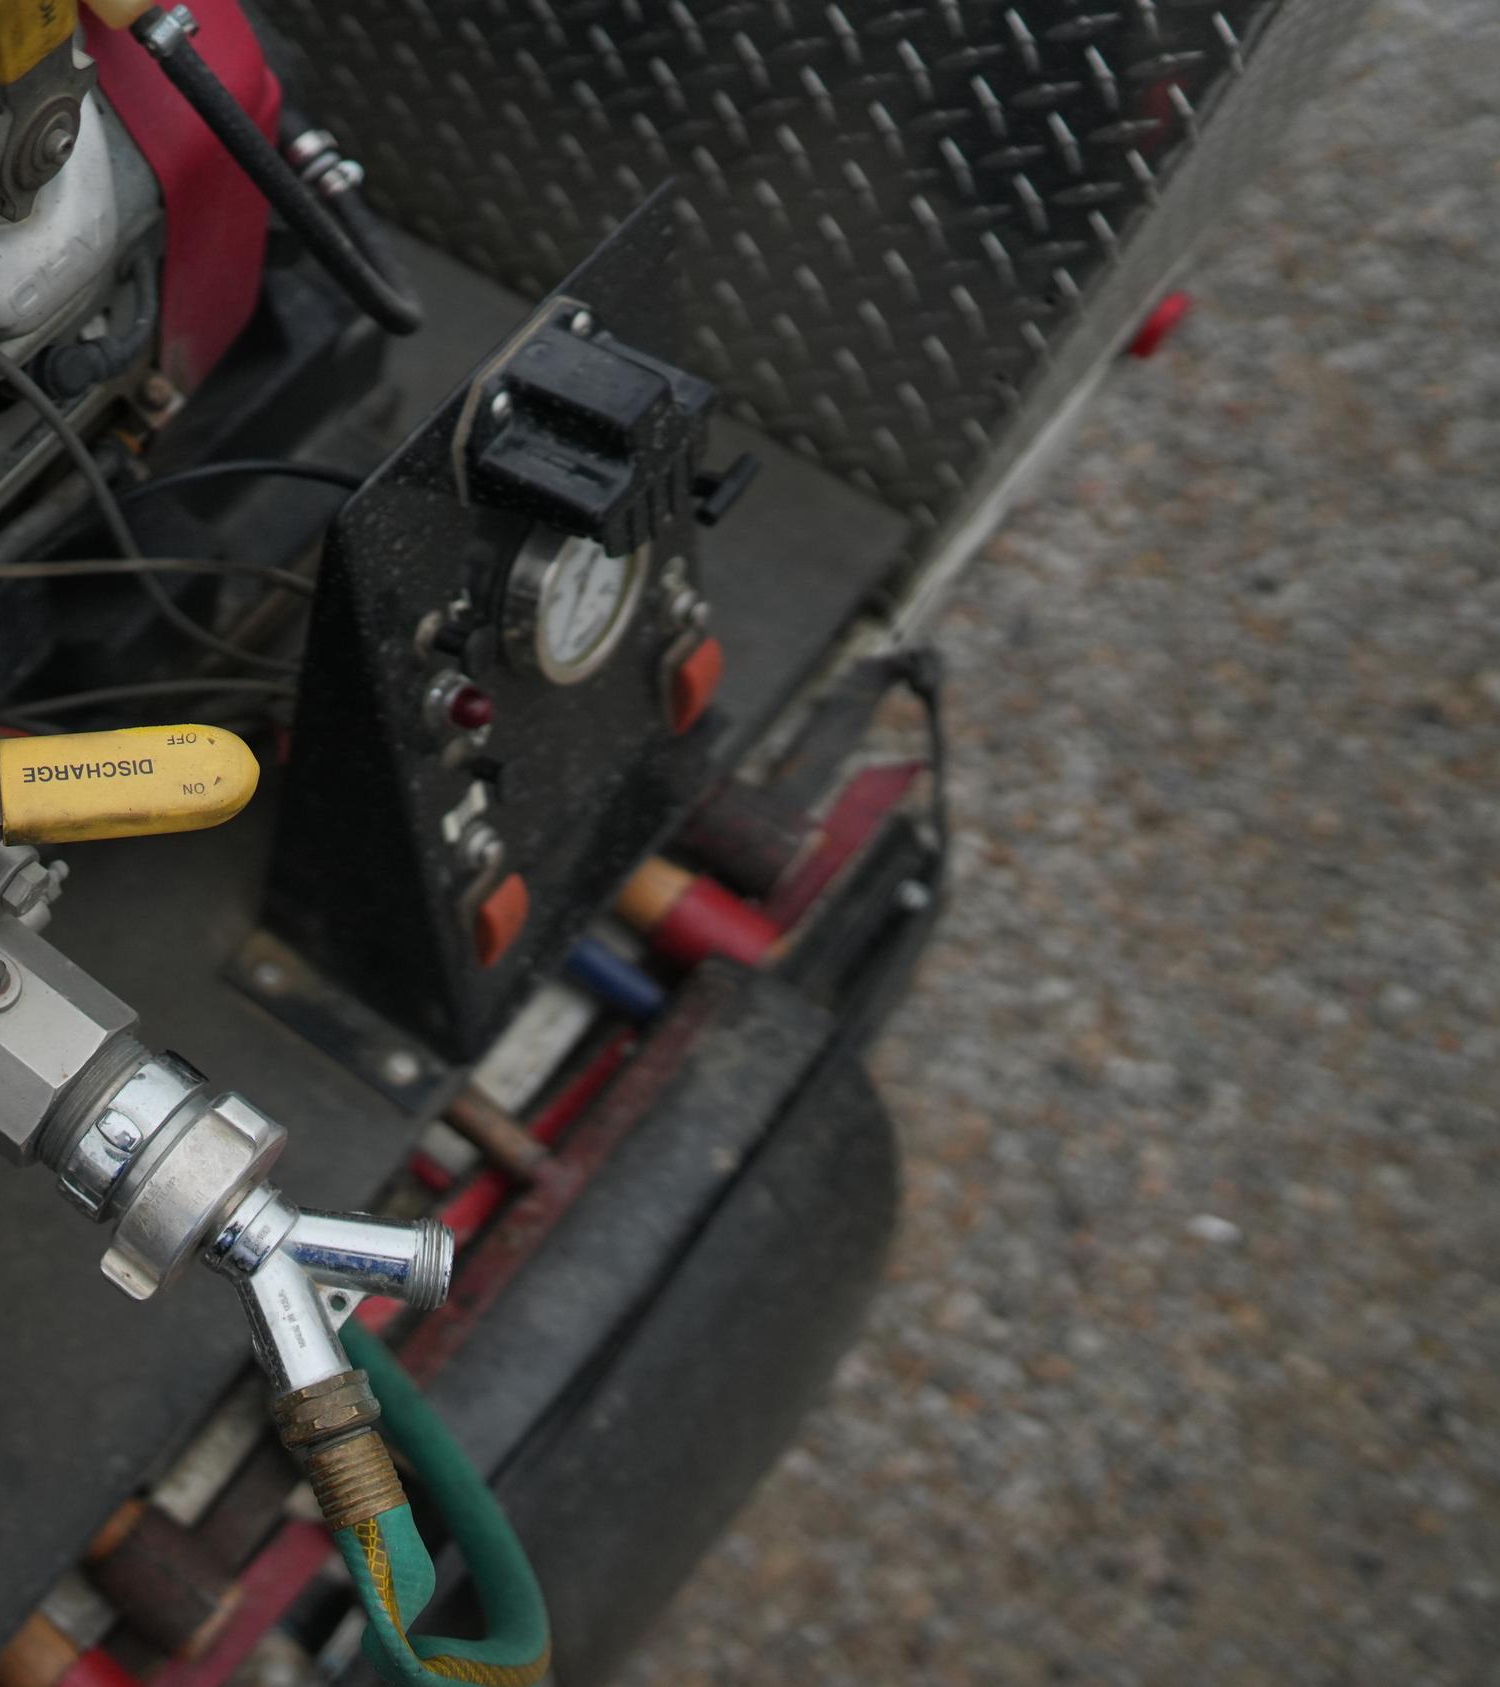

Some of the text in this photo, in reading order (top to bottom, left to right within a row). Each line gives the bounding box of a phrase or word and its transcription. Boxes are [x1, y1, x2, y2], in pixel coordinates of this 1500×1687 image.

[167, 732, 197, 746] OFF
[22, 758, 154, 783] DISCHARGE
[182, 782, 205, 795] ON
